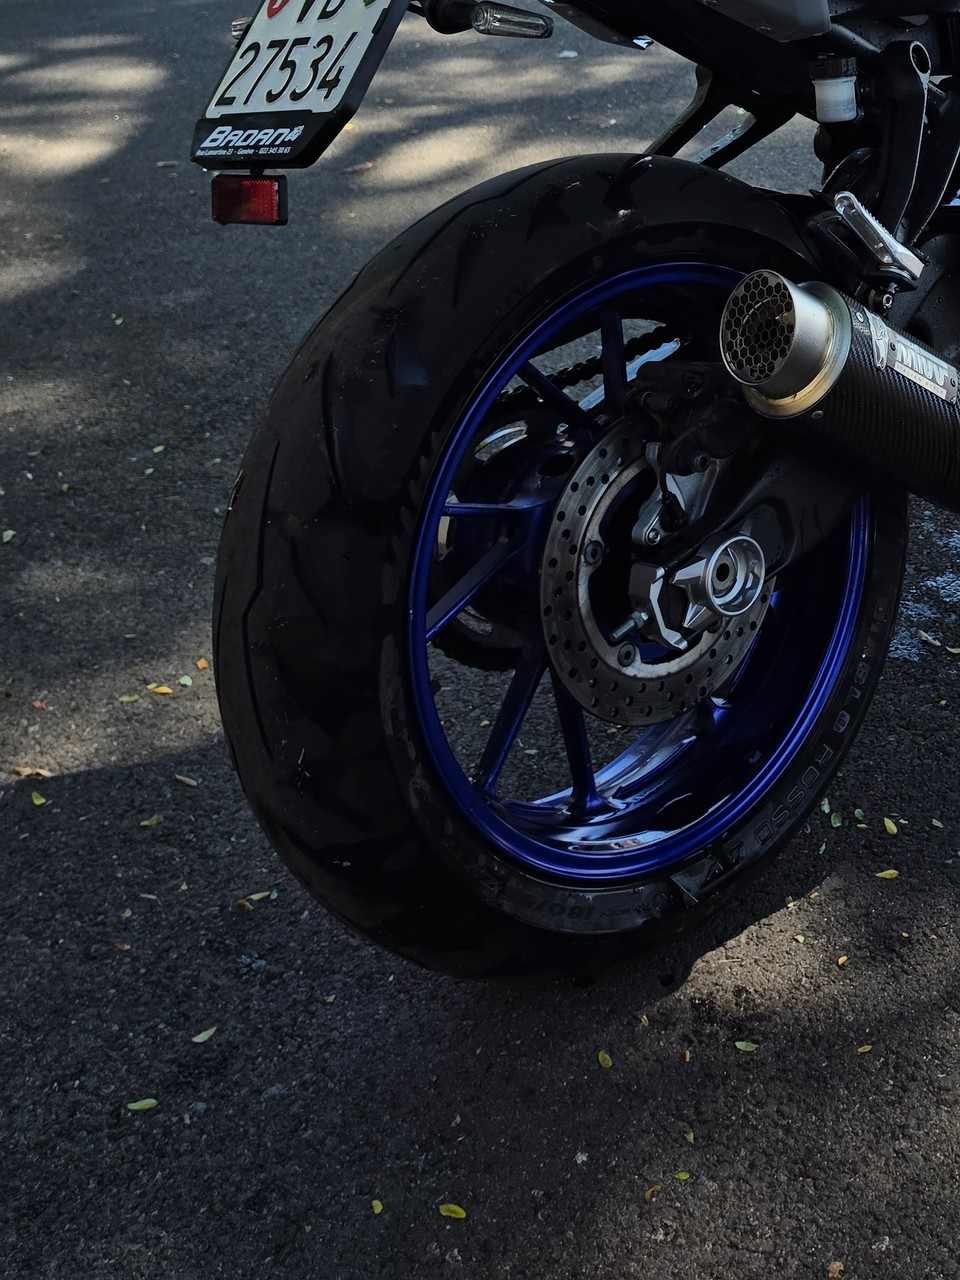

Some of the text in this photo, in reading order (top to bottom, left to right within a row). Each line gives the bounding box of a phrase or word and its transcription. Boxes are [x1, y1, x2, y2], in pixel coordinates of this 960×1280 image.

[215, 32, 357, 107] 27534
[200, 125, 291, 148] BADAN
[754, 743, 834, 845] ROSSO
